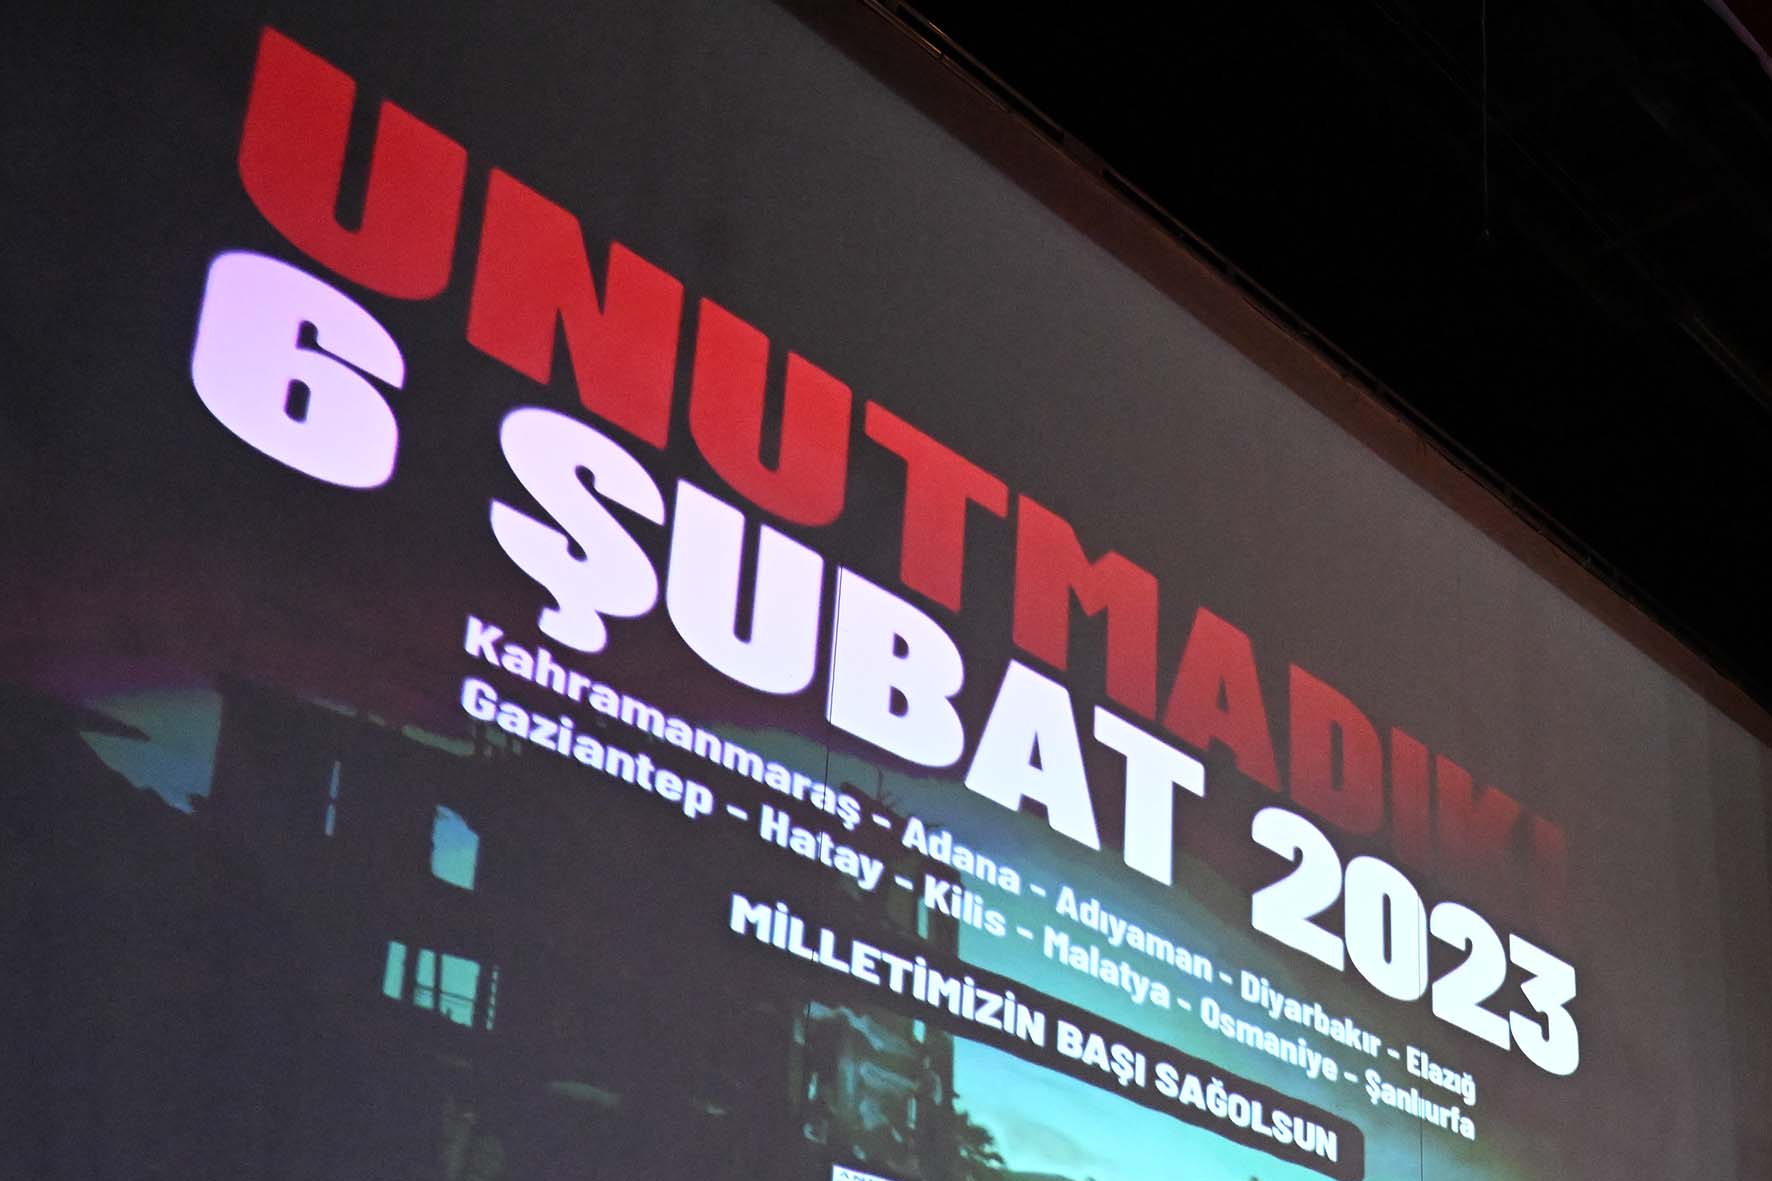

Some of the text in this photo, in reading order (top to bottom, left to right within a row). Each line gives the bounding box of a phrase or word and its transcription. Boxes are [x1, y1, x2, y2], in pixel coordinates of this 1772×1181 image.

[191, 250, 1580, 1076] 6 ŞUBAT 2023
[463, 614, 861, 828] Kahramanmaraş
[902, 816, 1021, 894] Adana
[1055, 886, 1213, 982] Adıyaman
[1241, 970, 1382, 1058] Diyarbakır
[1406, 1046, 1477, 1106] Elazığ
[461, 677, 713, 819] Gaziantep
[760, 803, 884, 891] Hatay
[924, 874, 1006, 937] Kilis
[1044, 925, 1171, 1009] Malatya
[1200, 998, 1339, 1081] Osmaniye
[1364, 1069, 1476, 1141] Şanlıurfa
[730, 894, 1339, 1162] MİLLETİMİZİN BAŞI SAĞOLSUN
